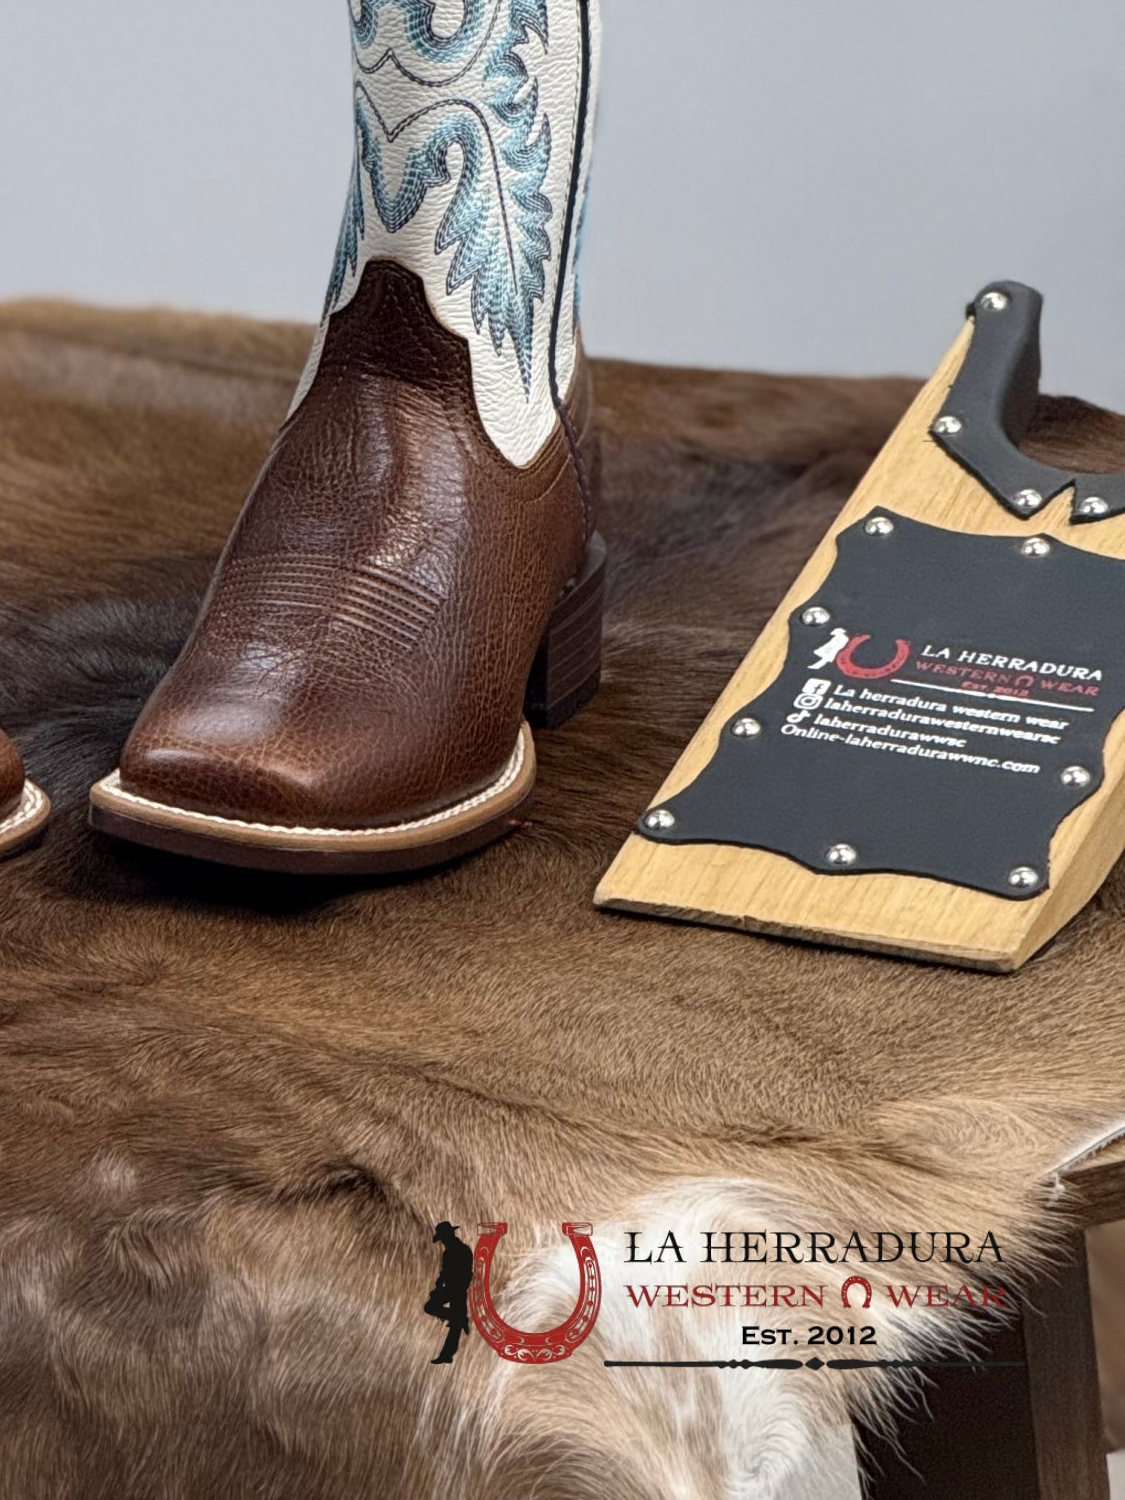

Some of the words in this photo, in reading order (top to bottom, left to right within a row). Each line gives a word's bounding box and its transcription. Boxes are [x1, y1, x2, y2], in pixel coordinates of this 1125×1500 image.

[915, 660, 1012, 684] WESTERN
[1039, 679, 1100, 697] WEAR
[920, 644, 950, 660] LA
[957, 650, 1103, 682] HERRADURA
[833, 684, 856, 697] La
[859, 688, 947, 712] herradura
[952, 704, 1021, 723] western
[1025, 715, 1070, 730] wear
